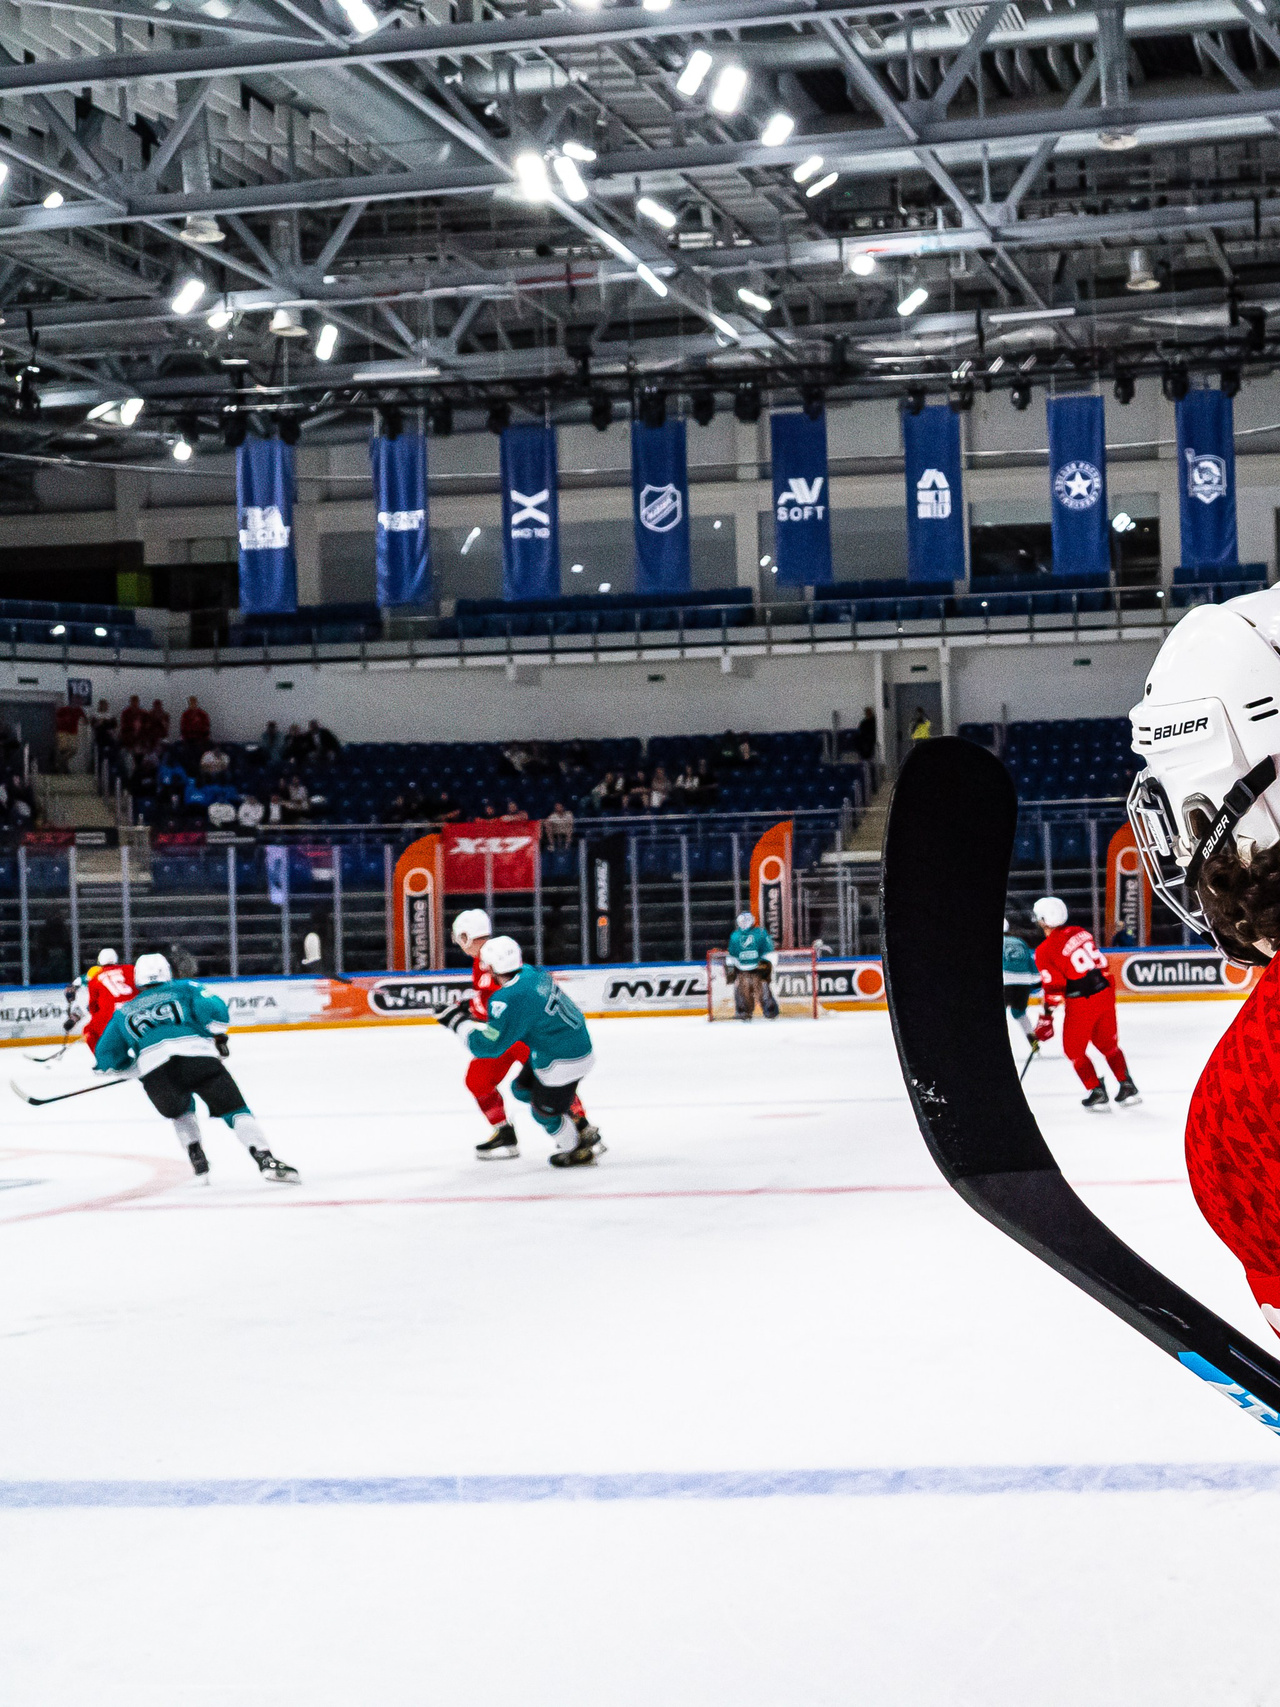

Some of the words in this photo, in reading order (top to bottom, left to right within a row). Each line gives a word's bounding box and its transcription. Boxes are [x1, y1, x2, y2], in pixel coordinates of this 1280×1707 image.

[776, 505, 825, 522] SOFT
[1153, 716, 1209, 741] BAUER
[1202, 814, 1231, 860] BAUER
[1121, 878, 1139, 934] inline
[1133, 961, 1217, 984] Winline
[608, 979, 708, 999] MHL
